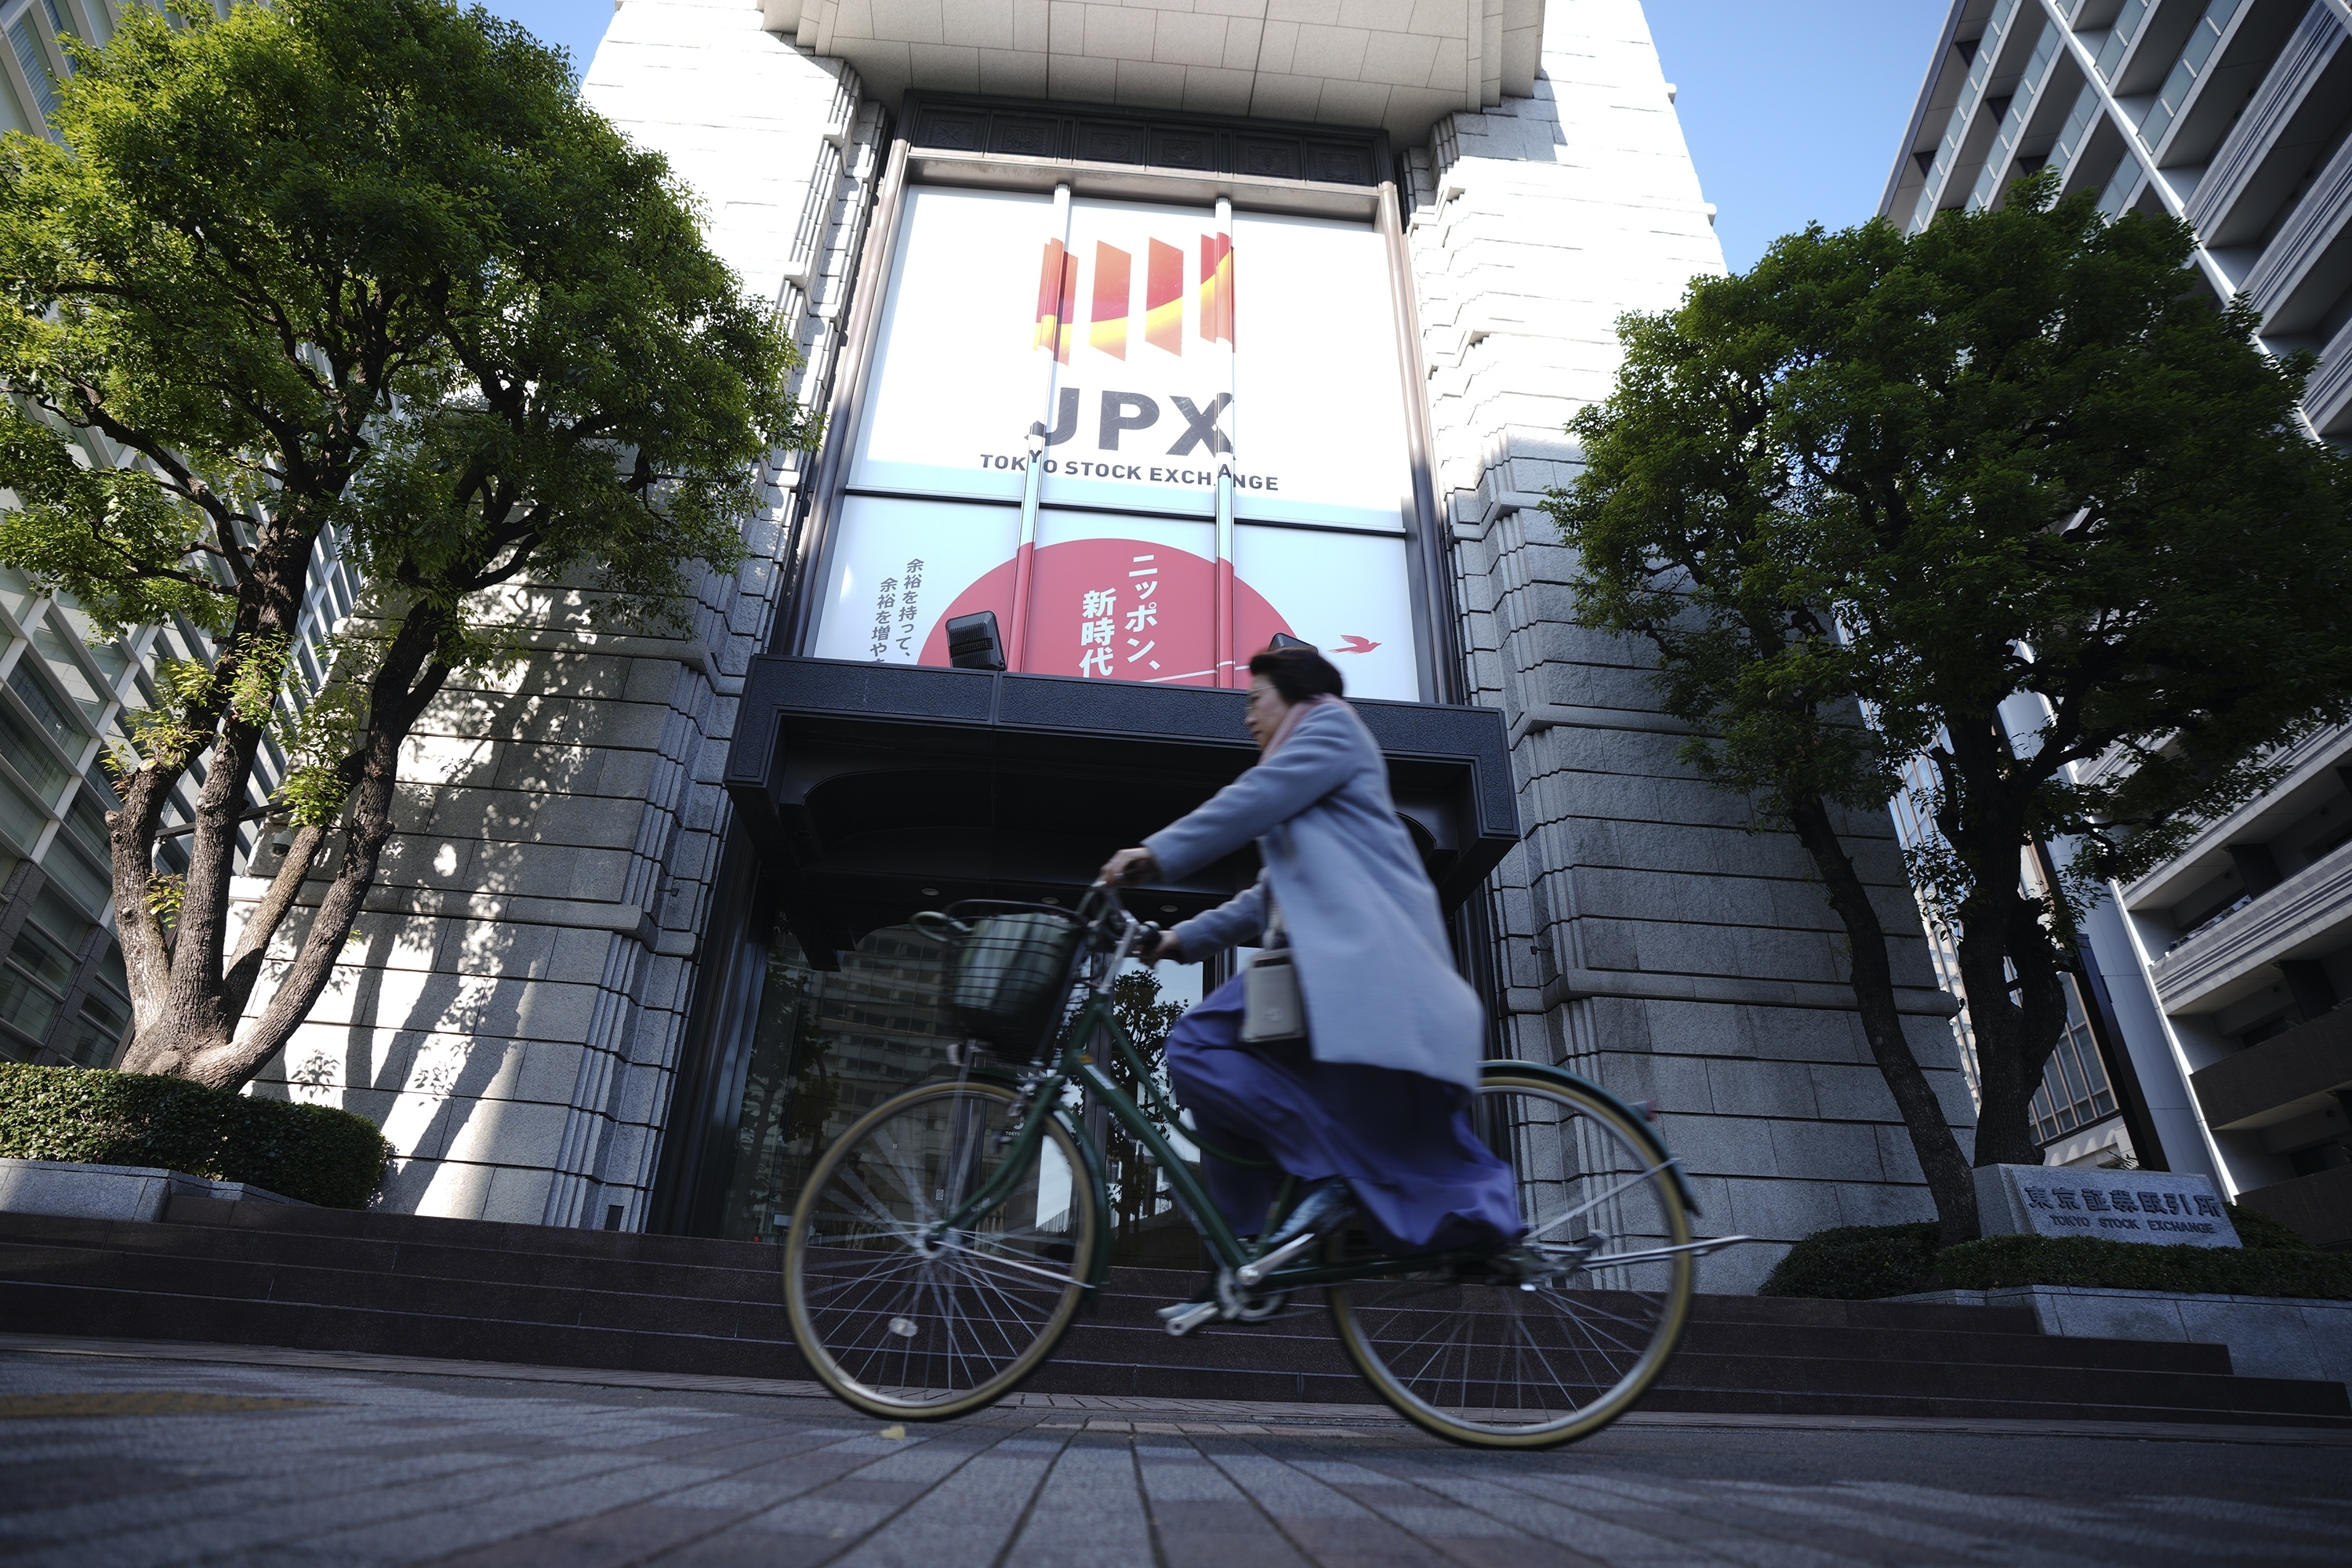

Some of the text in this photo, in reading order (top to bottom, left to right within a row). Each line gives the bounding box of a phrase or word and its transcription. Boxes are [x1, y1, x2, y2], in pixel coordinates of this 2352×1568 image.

[1023, 387, 1236, 460] JPX
[980, 449, 1279, 491] TOKYO STOCK EXCHANGE
[1079, 587, 1117, 678] 新時代
[2024, 1185, 2221, 1218] 東京証券取引所
[2049, 1214, 2216, 1233] TOKYO STOCK EXCHANGE
